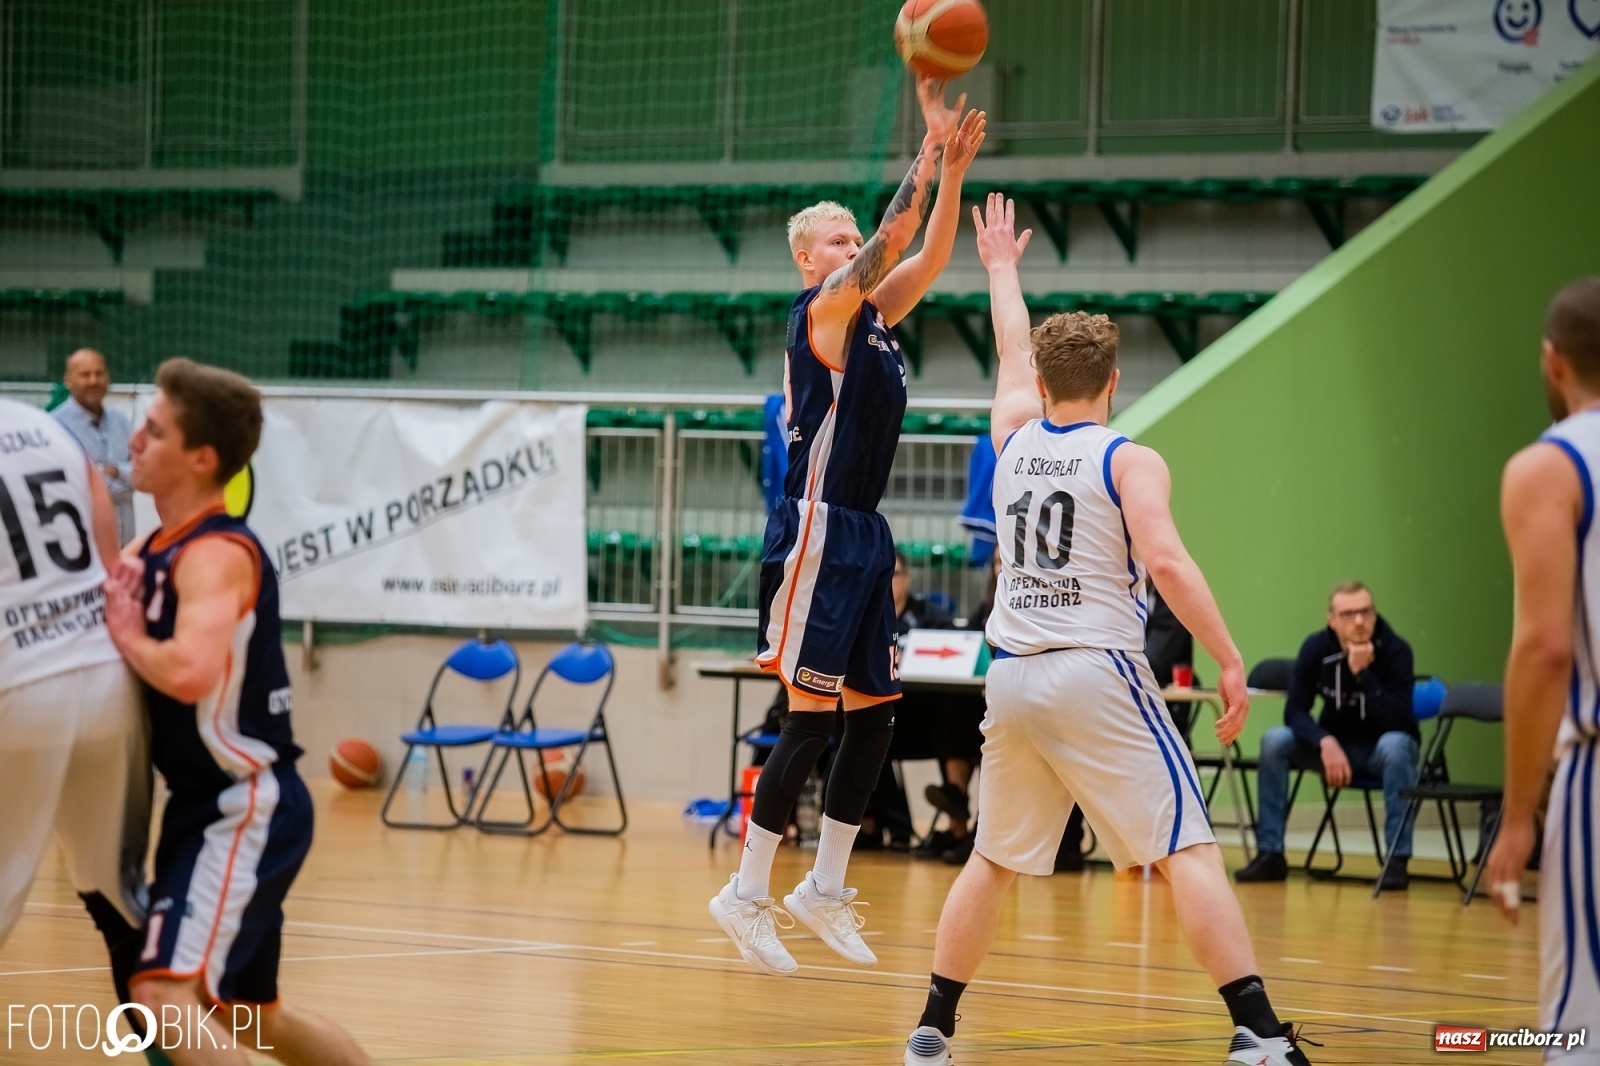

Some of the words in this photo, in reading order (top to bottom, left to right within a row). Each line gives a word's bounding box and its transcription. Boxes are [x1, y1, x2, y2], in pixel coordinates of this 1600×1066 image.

[0, 470, 91, 581] 15
[275, 522, 336, 577] JEST
[345, 509, 374, 545] W
[1006, 490, 1075, 570] 10
[1009, 589, 1082, 610] RACIBÓRZ
[812, 676, 835, 688] Energa
